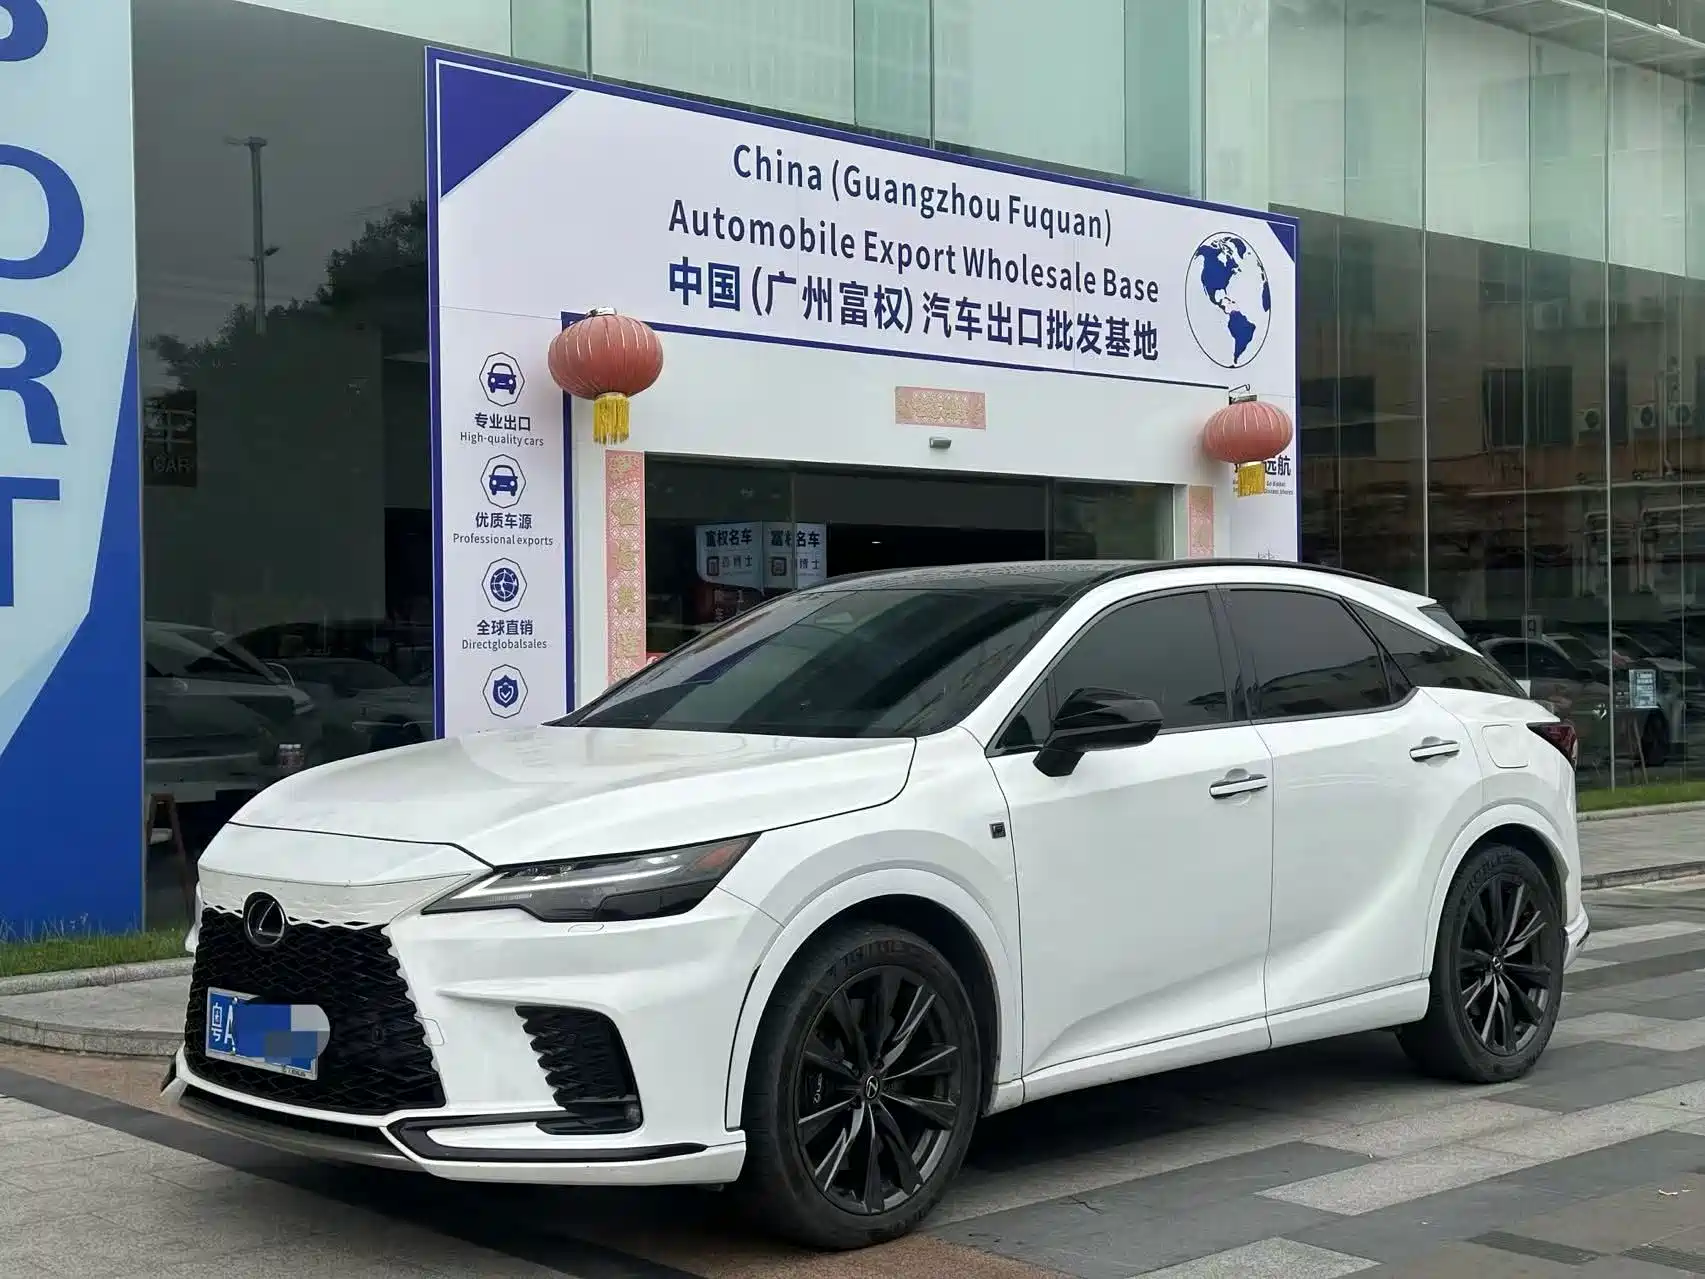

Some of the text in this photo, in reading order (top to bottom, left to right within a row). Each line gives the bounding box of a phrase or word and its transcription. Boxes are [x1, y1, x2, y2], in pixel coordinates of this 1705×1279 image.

[733, 144, 1111, 247] China (Guangzhou Fuquan)
[669, 200, 1159, 303] Automobile Export Wholesale Base
[474, 412, 531, 431] 专业出口
[460, 431, 544, 447] High-quality cars
[475, 512, 532, 530] 优质车源
[453, 533, 553, 547] Professional exports
[476, 619, 533, 636] 全球直销
[462, 639, 547, 652] Directglobalsales
